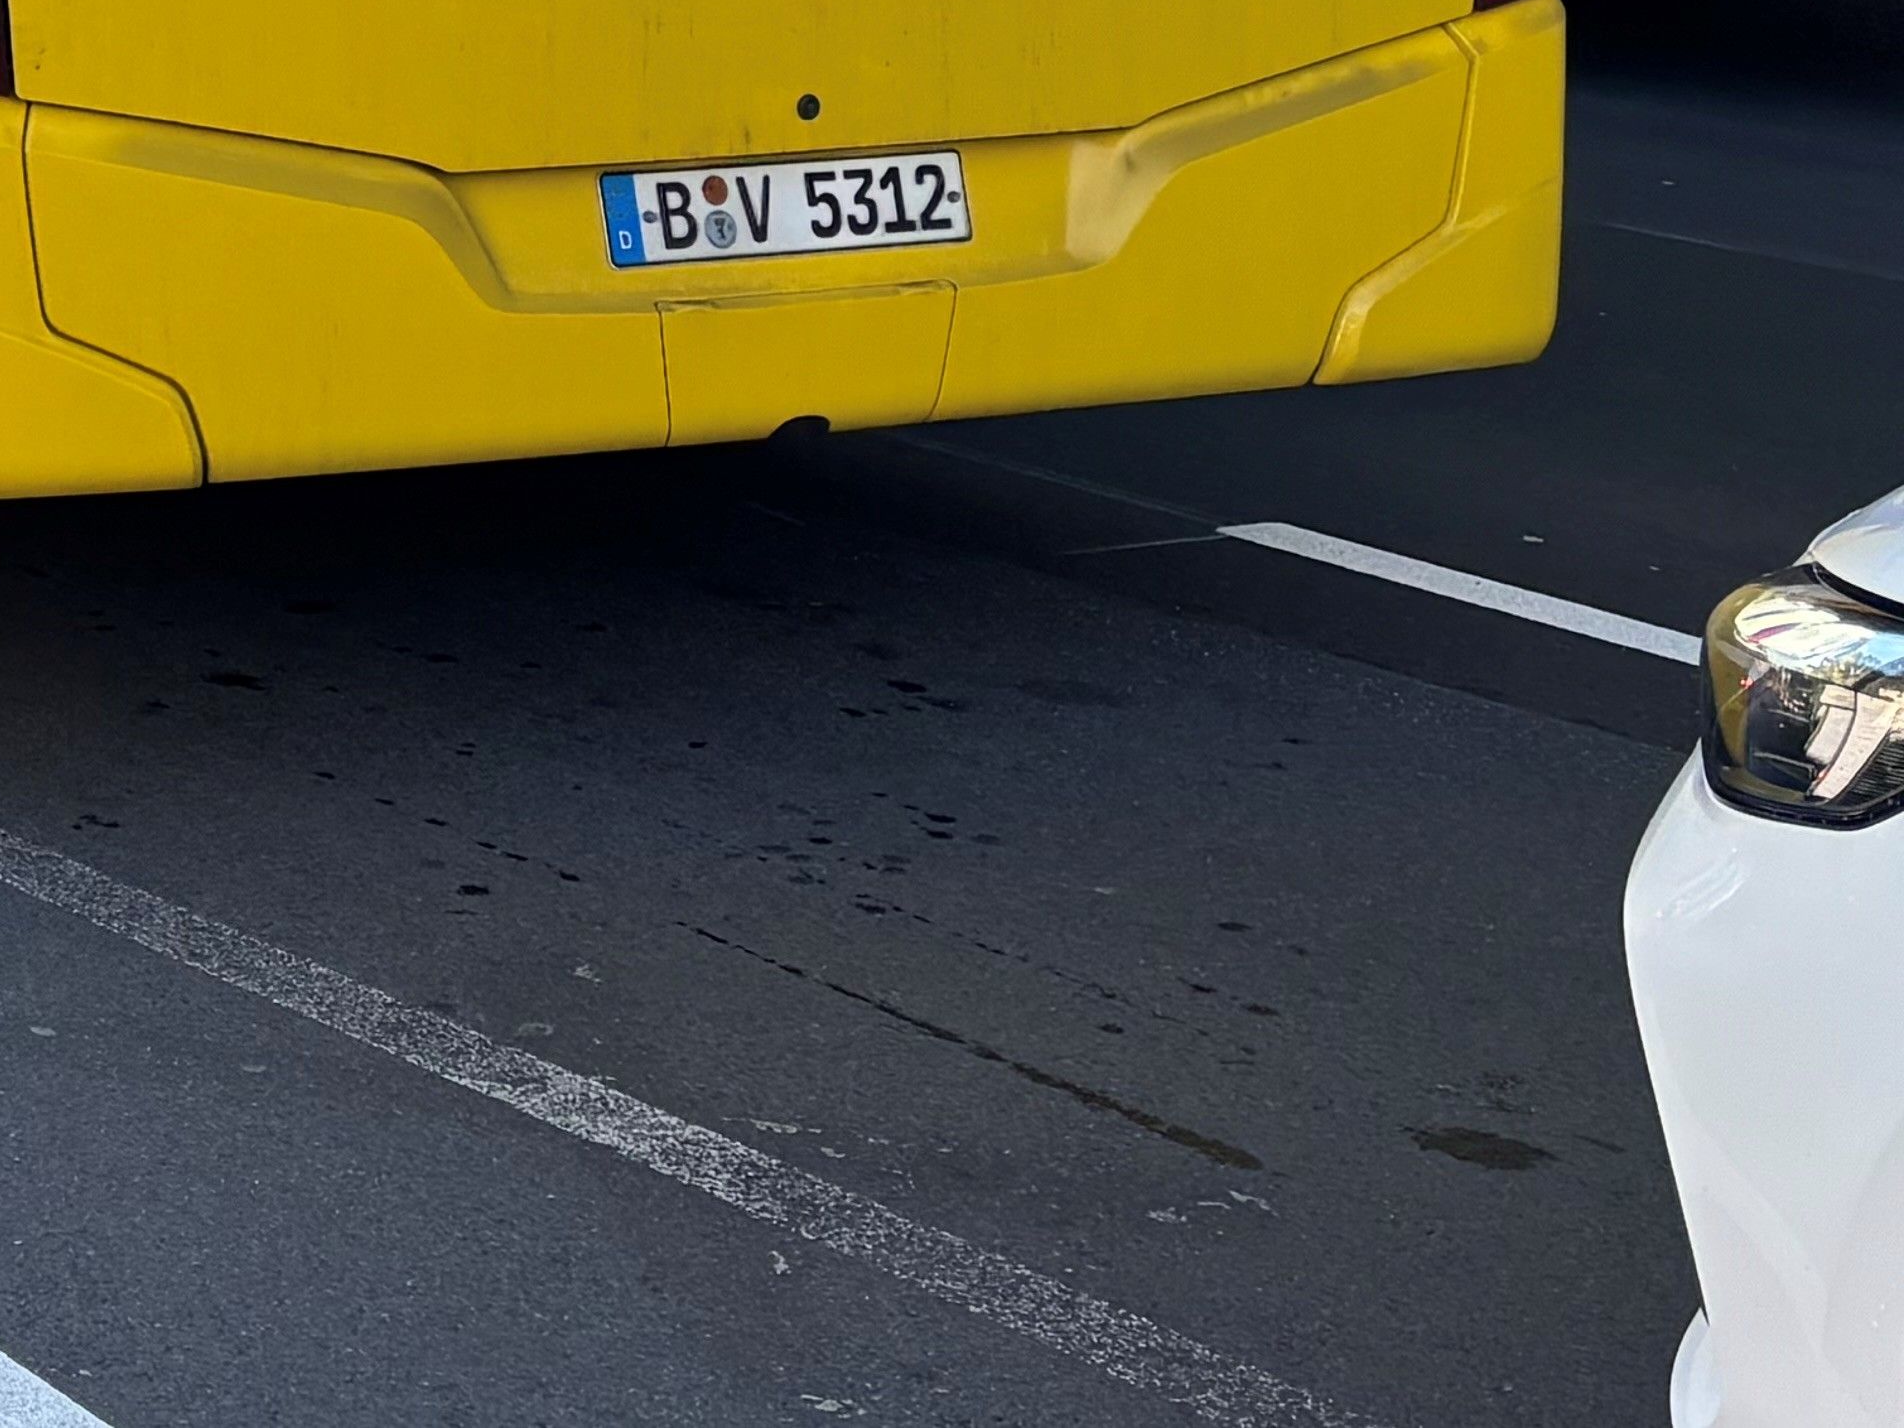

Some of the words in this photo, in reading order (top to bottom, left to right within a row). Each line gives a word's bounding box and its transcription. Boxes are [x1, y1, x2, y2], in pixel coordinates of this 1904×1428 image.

[619, 230, 633, 250] D
[656, 181, 699, 250] B
[735, 174, 771, 243] V
[804, 163, 954, 239] 5312
